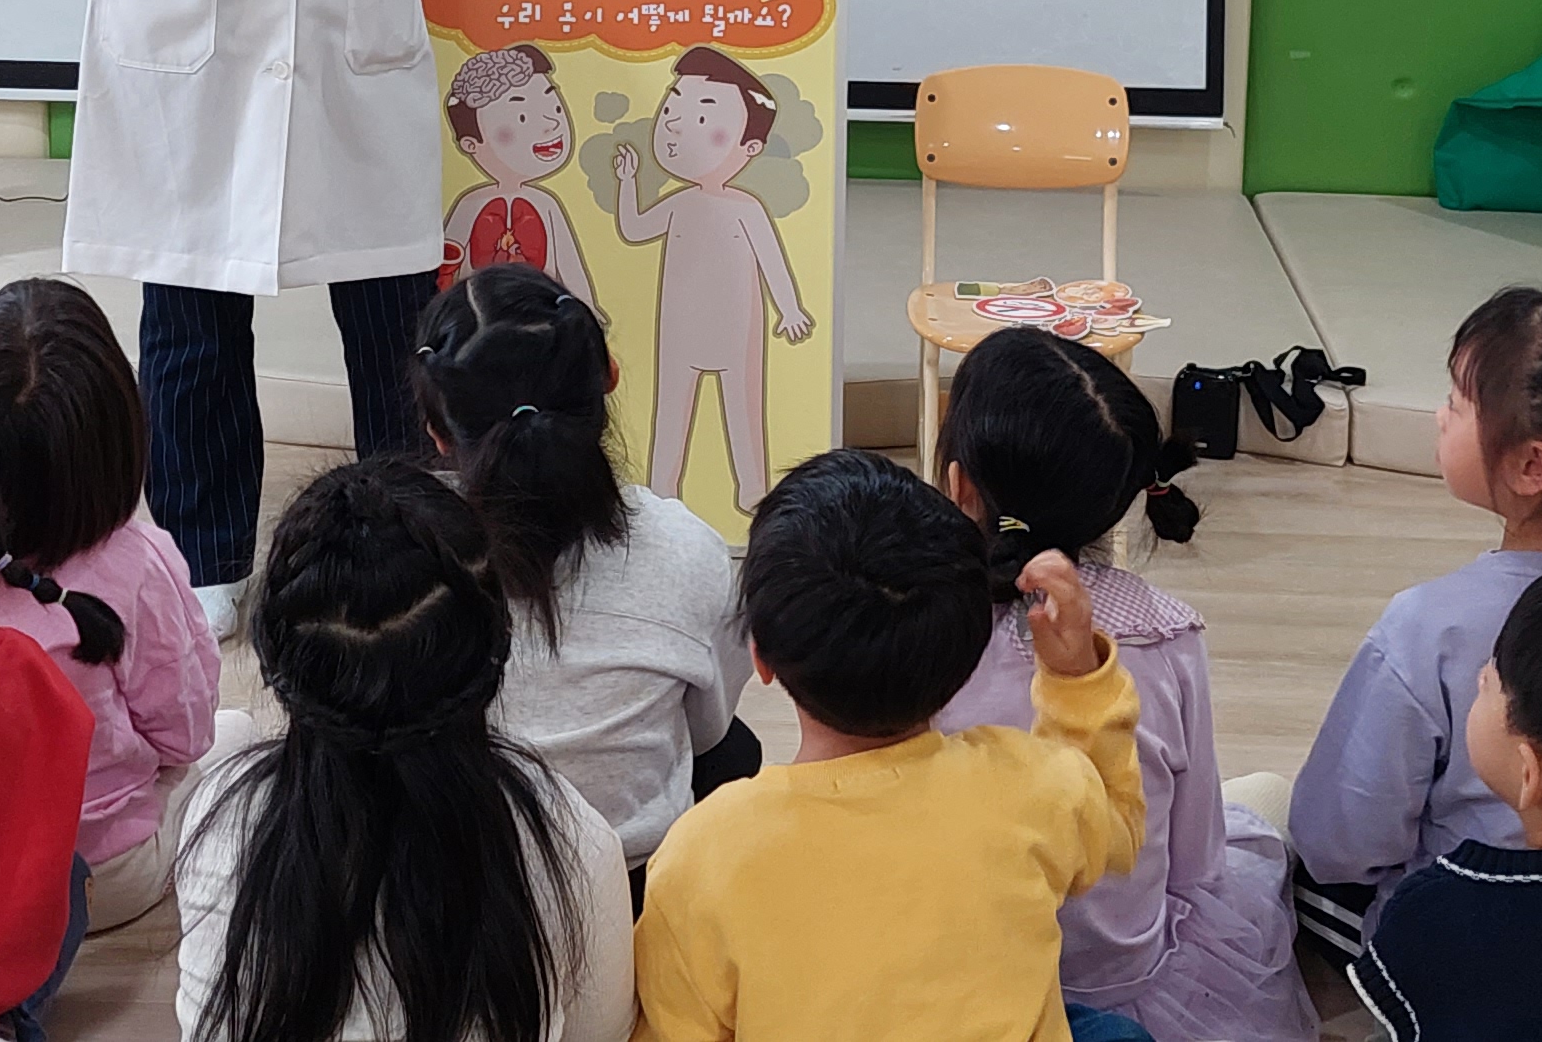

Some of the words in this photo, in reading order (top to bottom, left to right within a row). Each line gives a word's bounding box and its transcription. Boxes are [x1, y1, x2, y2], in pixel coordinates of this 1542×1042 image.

[495, 1, 543, 31] 우리
[557, 1, 604, 34] 몸이
[615, 2, 692, 33] 어떻게
[701, 2, 793, 38] 될까요?
